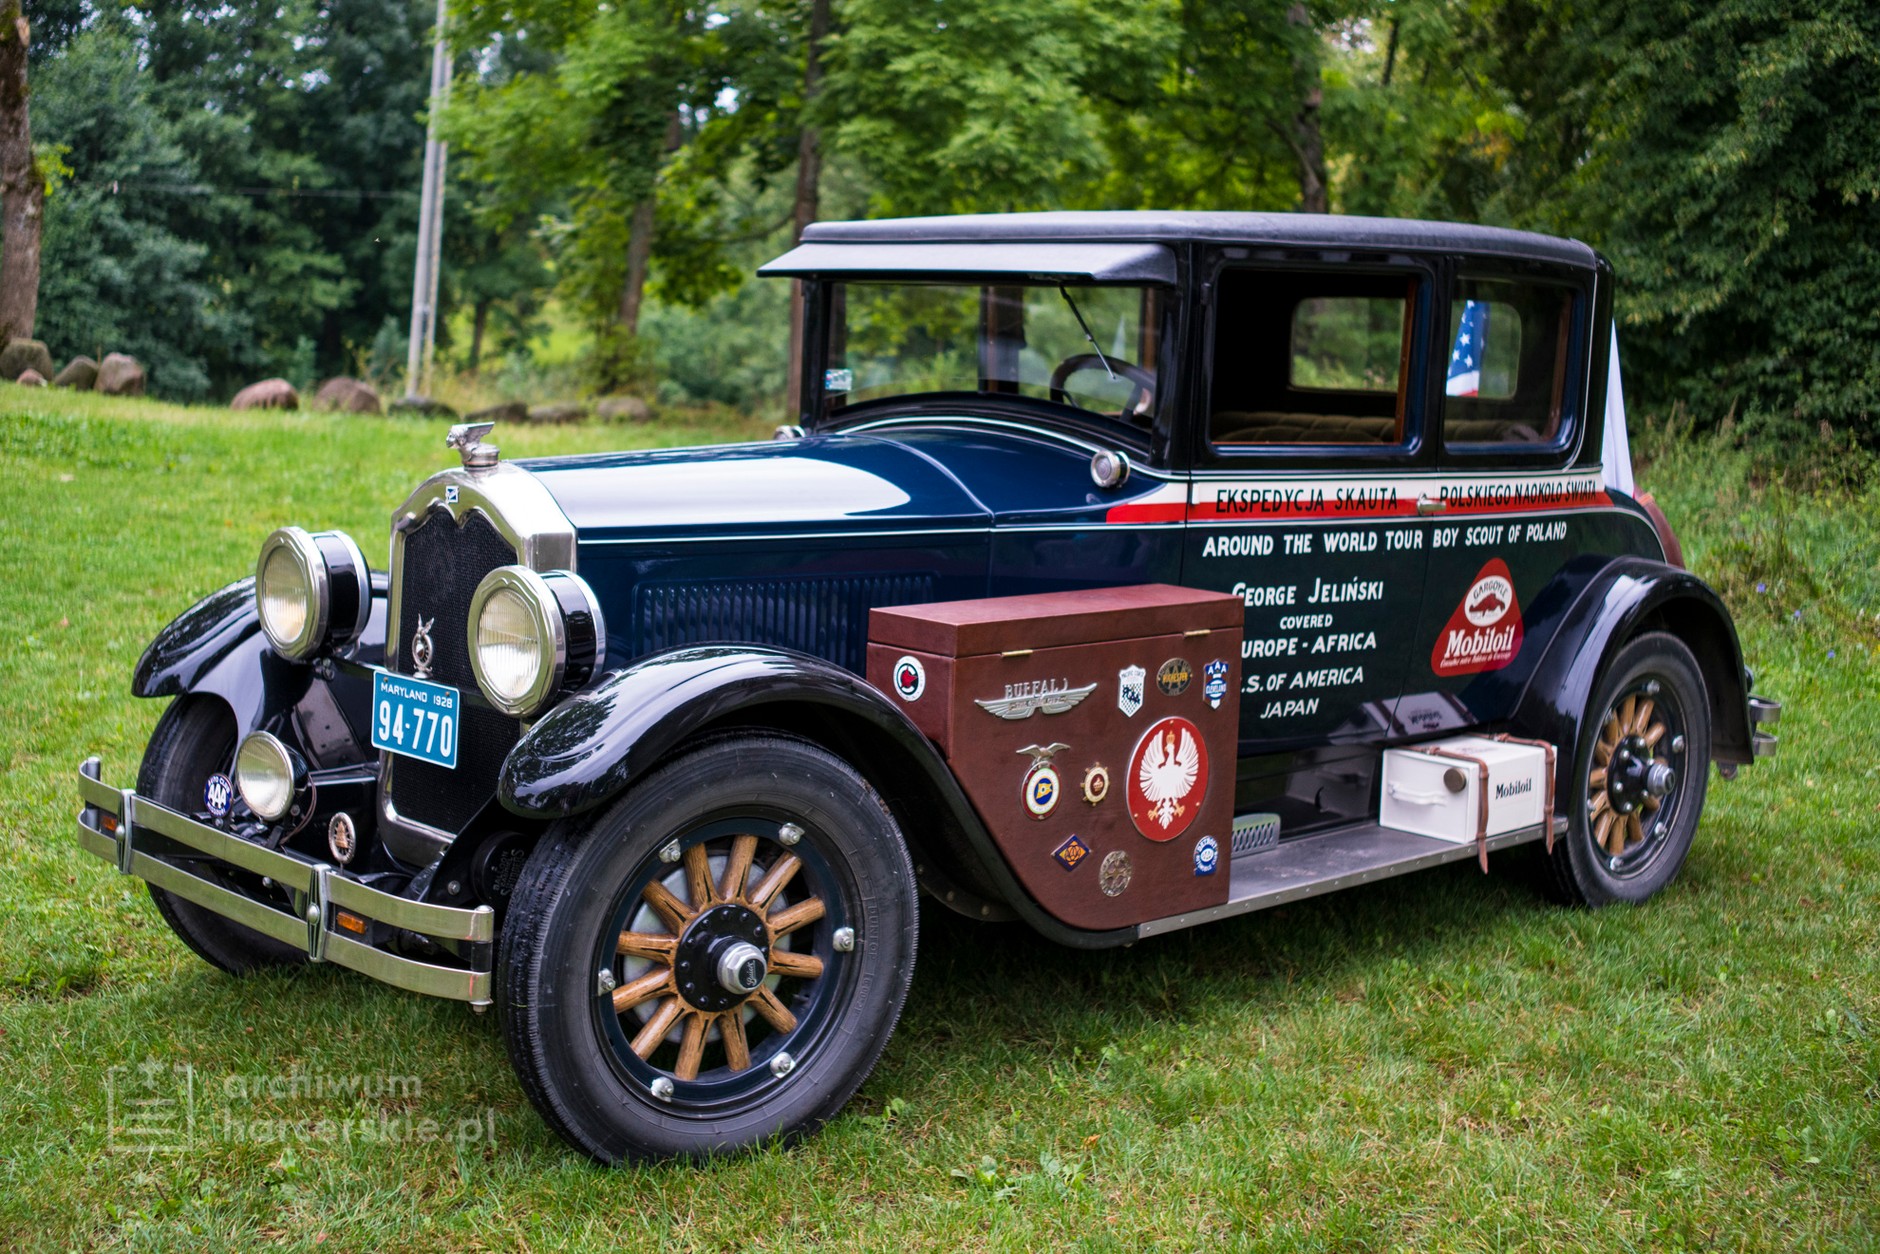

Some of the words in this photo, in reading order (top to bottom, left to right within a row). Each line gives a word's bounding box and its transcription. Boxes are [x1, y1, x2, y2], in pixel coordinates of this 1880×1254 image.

[1215, 488, 1325, 513] EKSPEDYCJA
[1334, 487, 1398, 511] SKAUTA
[1440, 483, 1511, 508] POLSKIEGO
[1202, 534, 1274, 557] AROUND
[1283, 533, 1313, 555] THE
[1323, 531, 1378, 553] WORLD
[1385, 529, 1423, 550] TOUR
[1432, 527, 1460, 548] BOY
[1465, 525, 1504, 546] SCOUT
[1508, 524, 1521, 544] OF
[1526, 521, 1567, 542] POLAND
[1232, 582, 1297, 607] GEORGE
[1307, 576, 1384, 604] JELIŃSKI
[1473, 580, 1508, 600] GARGOYLE
[1279, 613, 1333, 630] COVERED
[1241, 637, 1298, 659] UROPE
[1311, 631, 1377, 654] AFRICA
[1444, 624, 1516, 658] Mobiloil
[1266, 673, 1287, 692] OF
[1289, 666, 1364, 690] AMERICA
[380, 682, 428, 703] MARYLAND
[433, 695, 453, 709] 1928
[1260, 697, 1319, 719] JAPAN
[207, 782, 227, 809] AAA
[1495, 777, 1532, 800] Mobiloil
